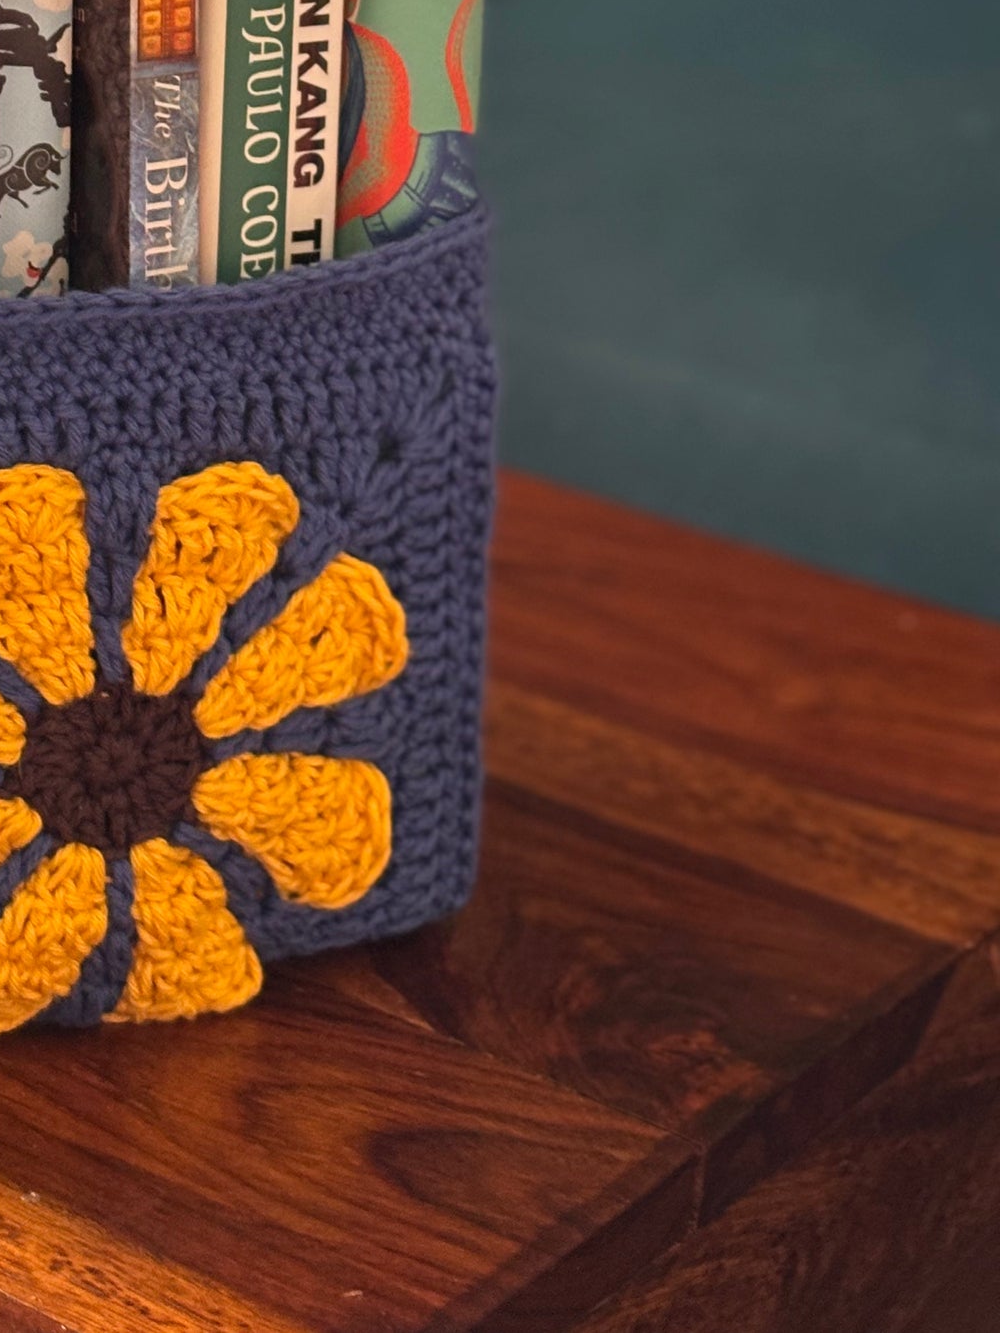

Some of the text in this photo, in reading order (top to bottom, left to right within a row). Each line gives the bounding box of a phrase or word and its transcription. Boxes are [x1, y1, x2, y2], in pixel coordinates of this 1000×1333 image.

[241, 2, 287, 165] PAULO
[293, 39, 330, 189] KANG
[144, 74, 189, 292] The Birth
